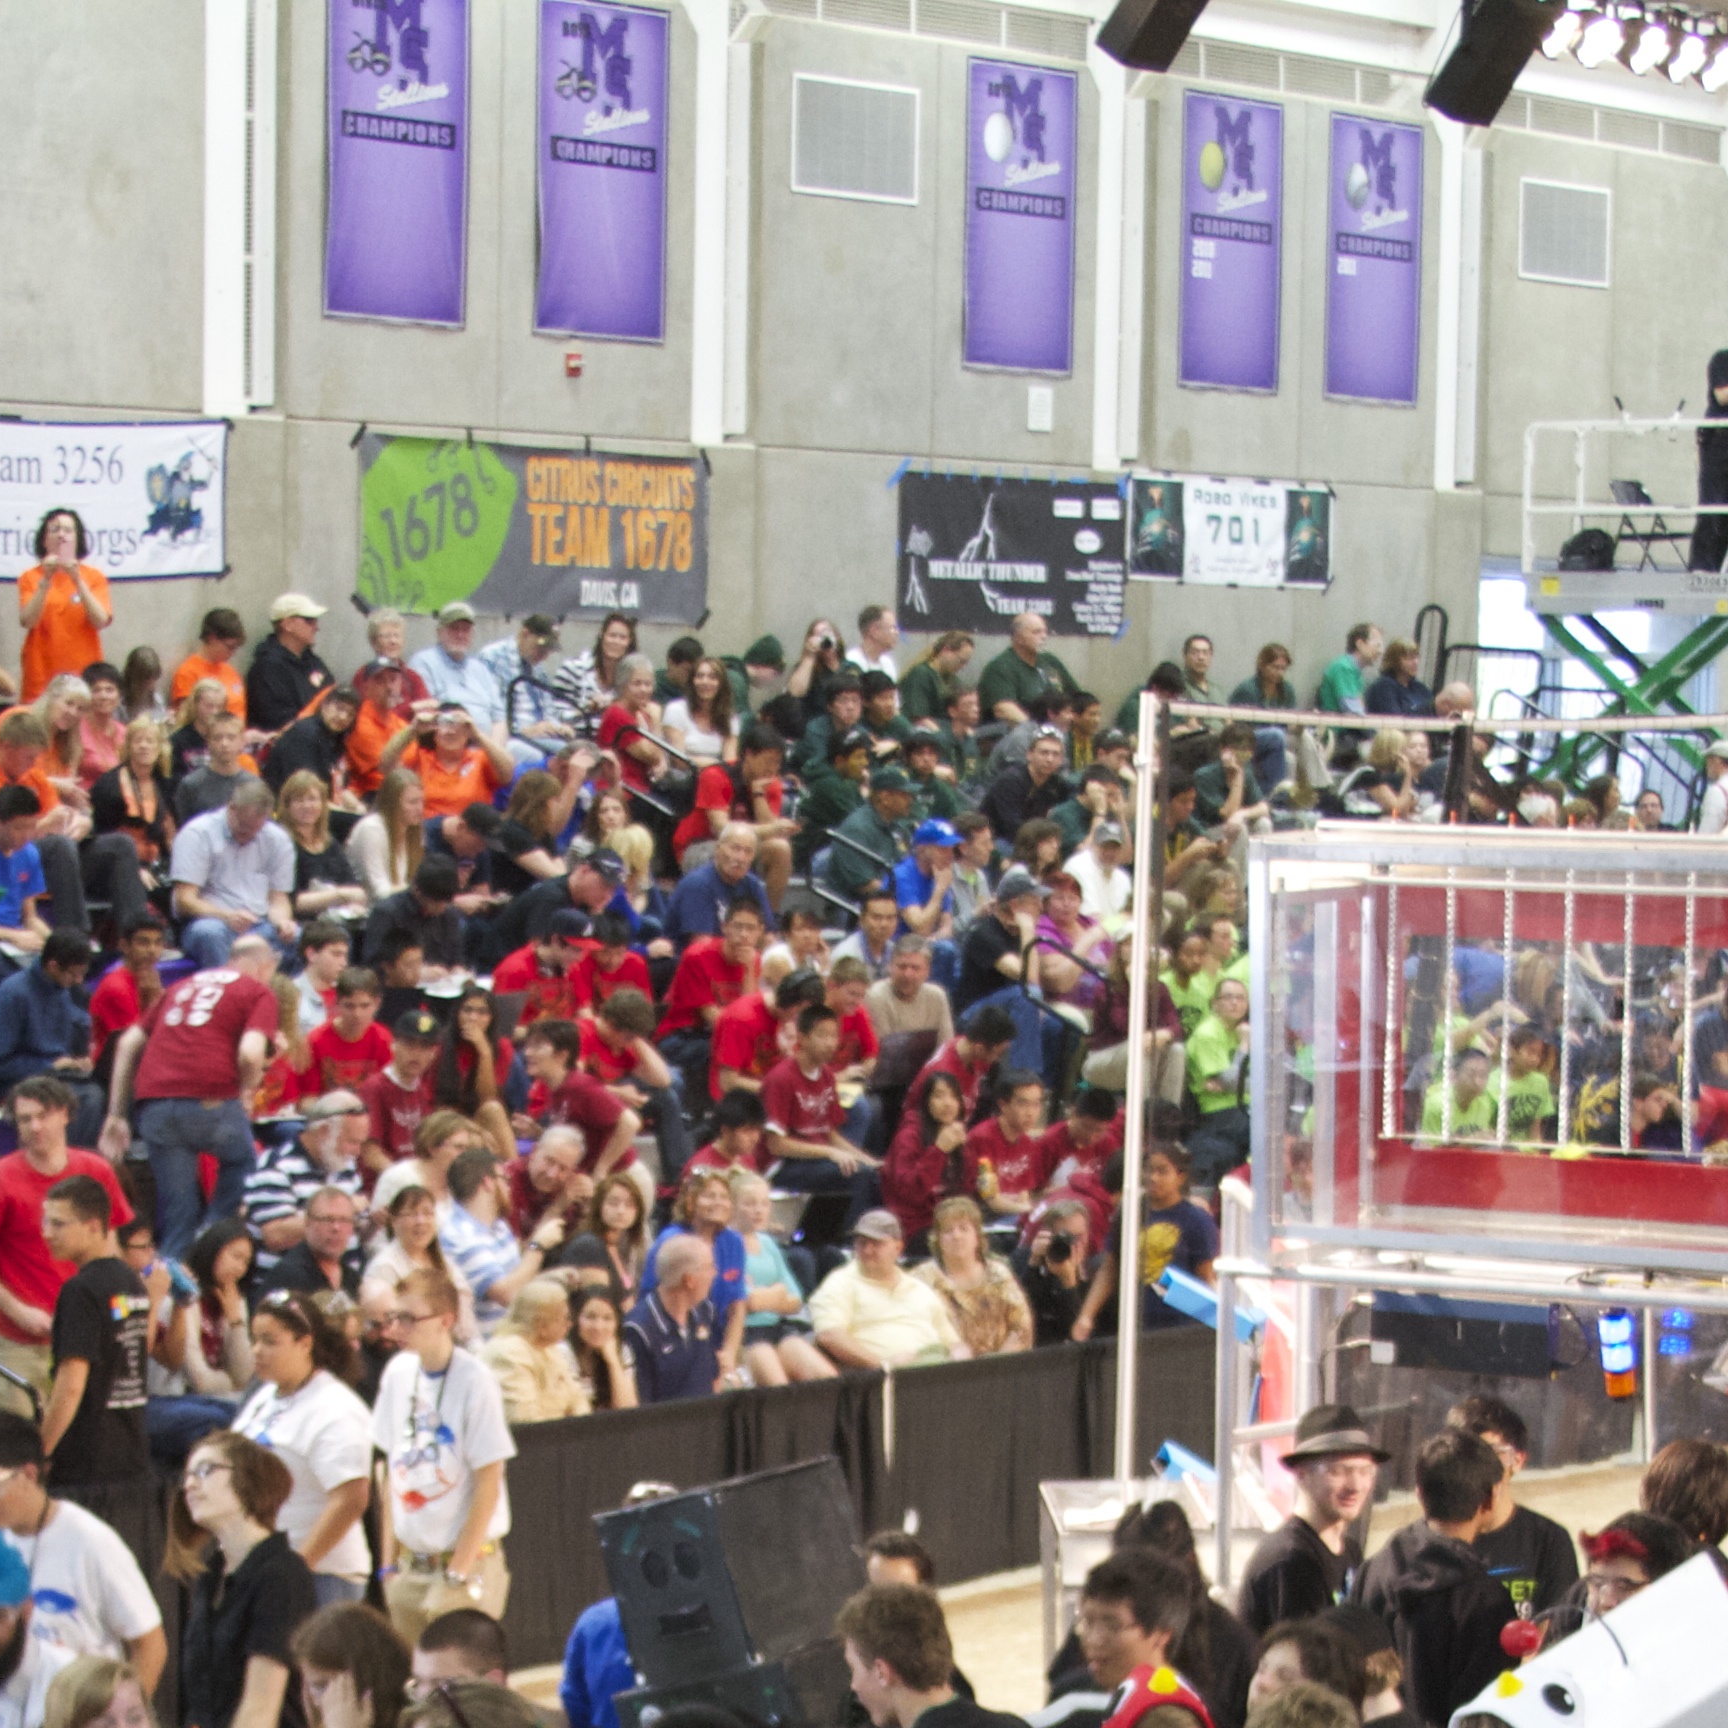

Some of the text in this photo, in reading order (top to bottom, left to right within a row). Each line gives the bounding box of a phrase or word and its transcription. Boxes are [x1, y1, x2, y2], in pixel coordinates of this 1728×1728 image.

[344, 113, 453, 148] CHAMPIONS
[556, 139, 653, 171] CHAMPIONS
[979, 191, 1063, 217] CHAMPIONS
[54, 444, 124, 485] 3256
[527, 456, 696, 510] CITRUS CIRCUITS
[1239, 492, 1277, 508] VIKES
[380, 472, 480, 570] 1678
[1206, 514, 1260, 544] 701
[527, 502, 693, 573] TEAM 1678
[928, 559, 1047, 582] METALLIC THUNDER
[621, 580, 640, 608] CA
